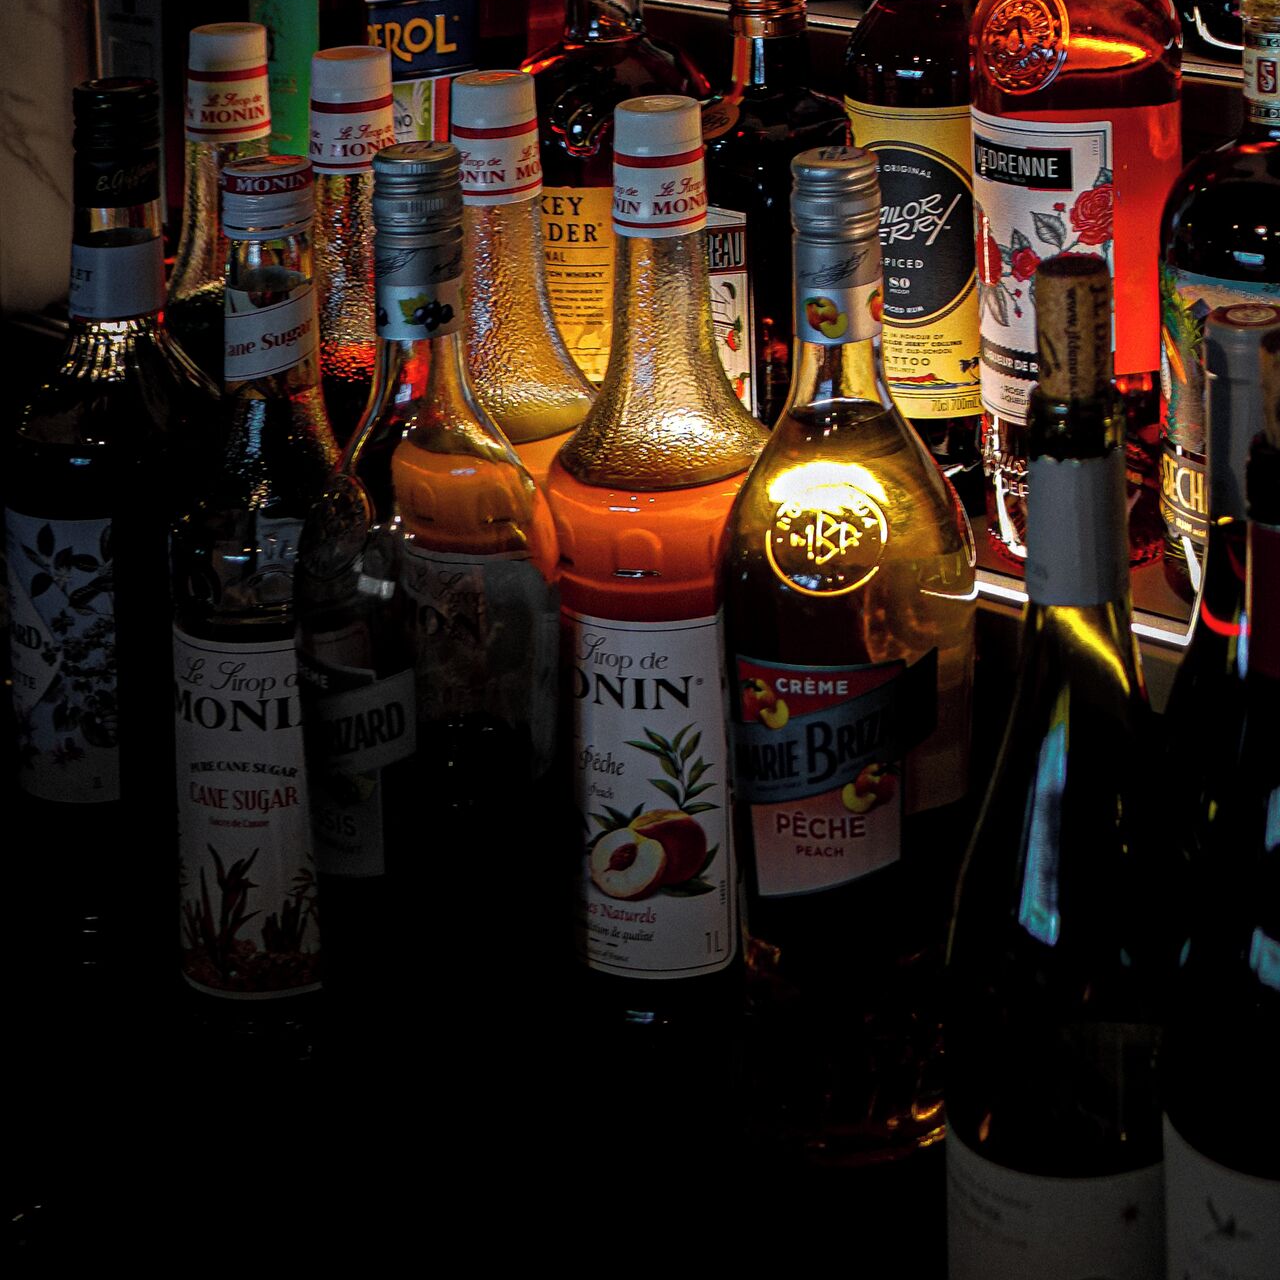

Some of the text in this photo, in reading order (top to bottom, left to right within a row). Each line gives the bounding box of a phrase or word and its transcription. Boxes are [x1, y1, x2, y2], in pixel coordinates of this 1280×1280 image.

[200, 104, 265, 123] MONIN
[330, 134, 398, 158] MONIN
[883, 164, 932, 179] ORIGINAL
[236, 174, 306, 192] MONIN
[576, 632, 669, 674] Sirop de
[211, 660, 277, 698] Sirop
[775, 675, 849, 697] CRÈME
[219, 760, 251, 773] CANE
[253, 762, 298, 779] SUGAR
[190, 781, 300, 814] CANE SUGAR
[776, 810, 867, 842] PÊCHE
[795, 843, 845, 858] PEACH
